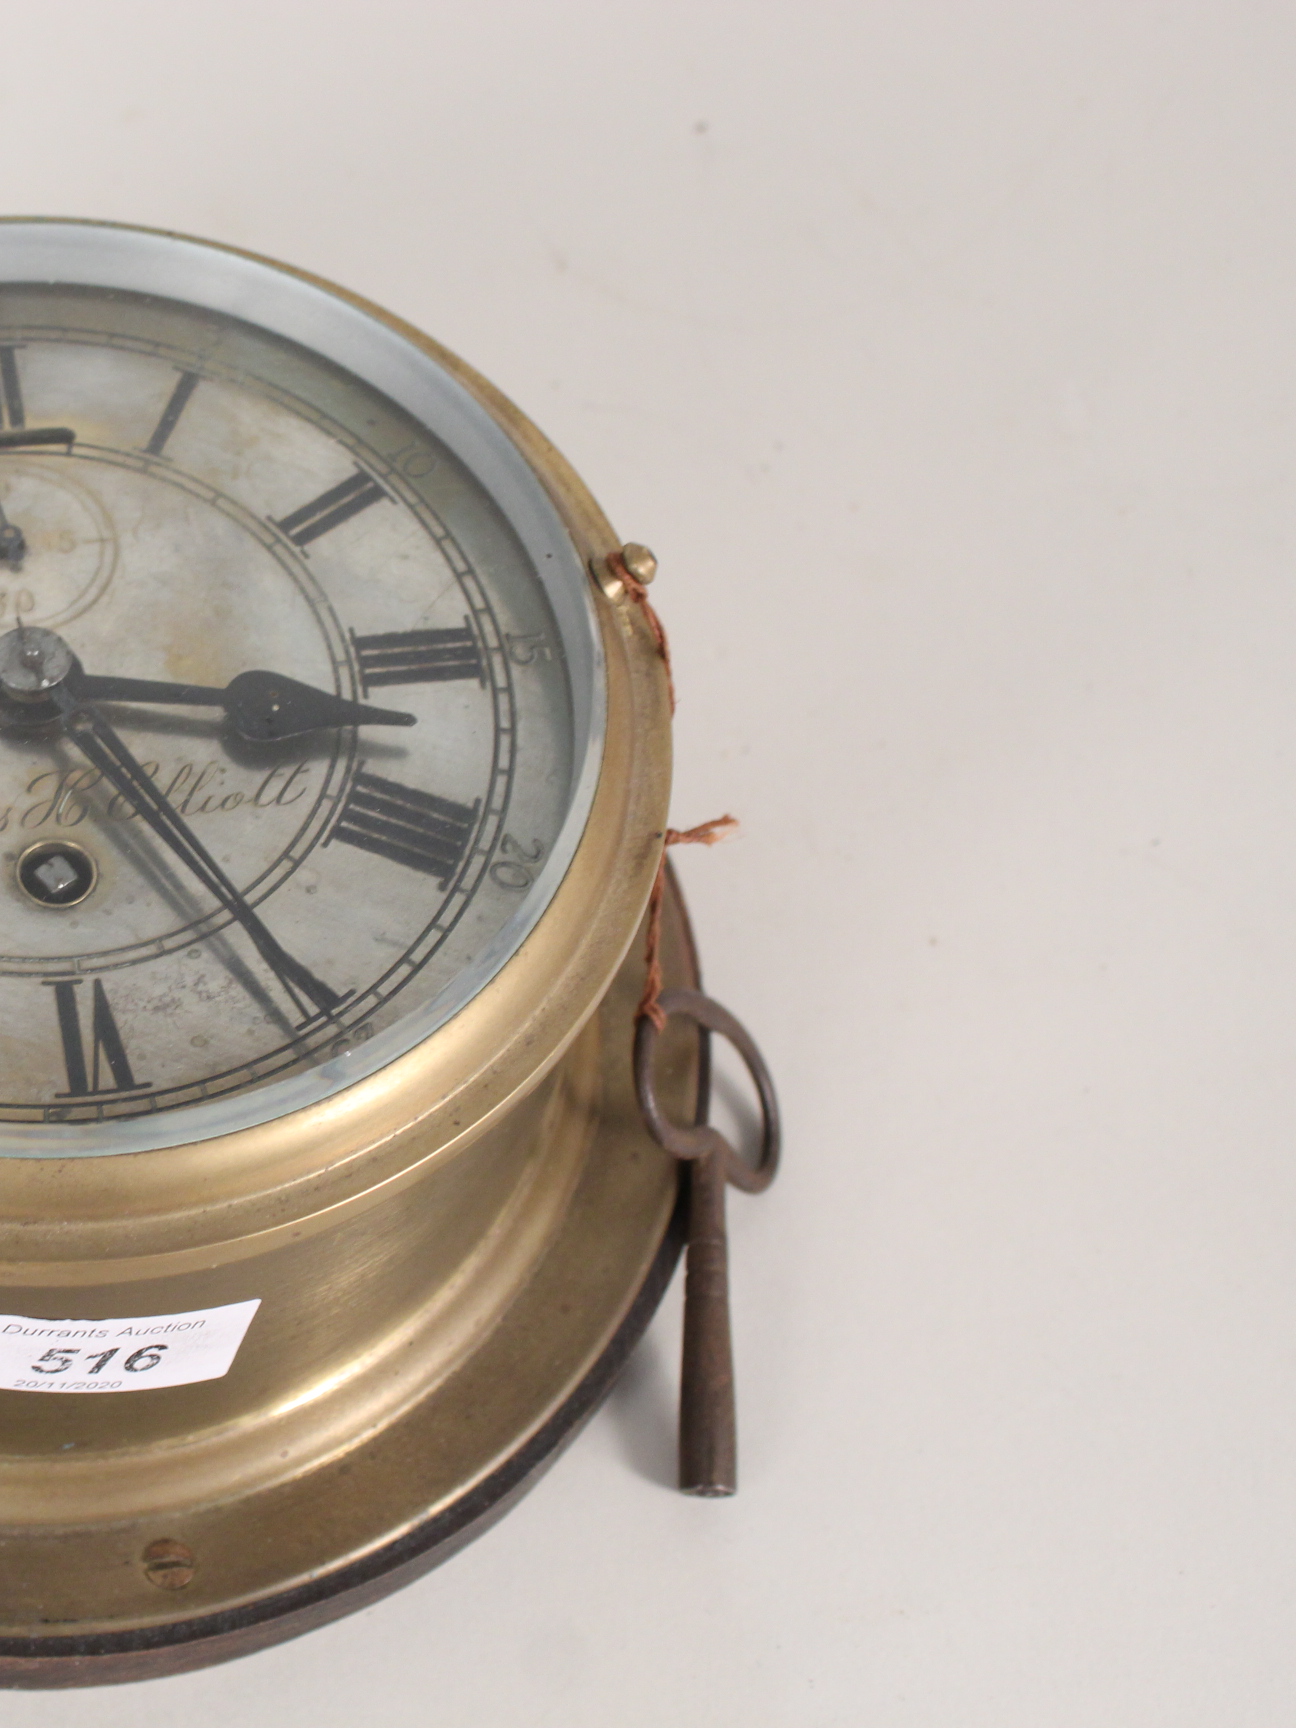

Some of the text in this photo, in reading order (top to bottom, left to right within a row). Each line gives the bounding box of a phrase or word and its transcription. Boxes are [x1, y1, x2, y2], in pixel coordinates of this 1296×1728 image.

[349, 613, 488, 700] III
[505, 631, 552, 667] 15
[489, 833, 545, 892] 20
[2, 1319, 206, 1338] Durrants Auction
[31, 1344, 169, 1375] 516
[13, 1379, 123, 1391] 20/11/2020
